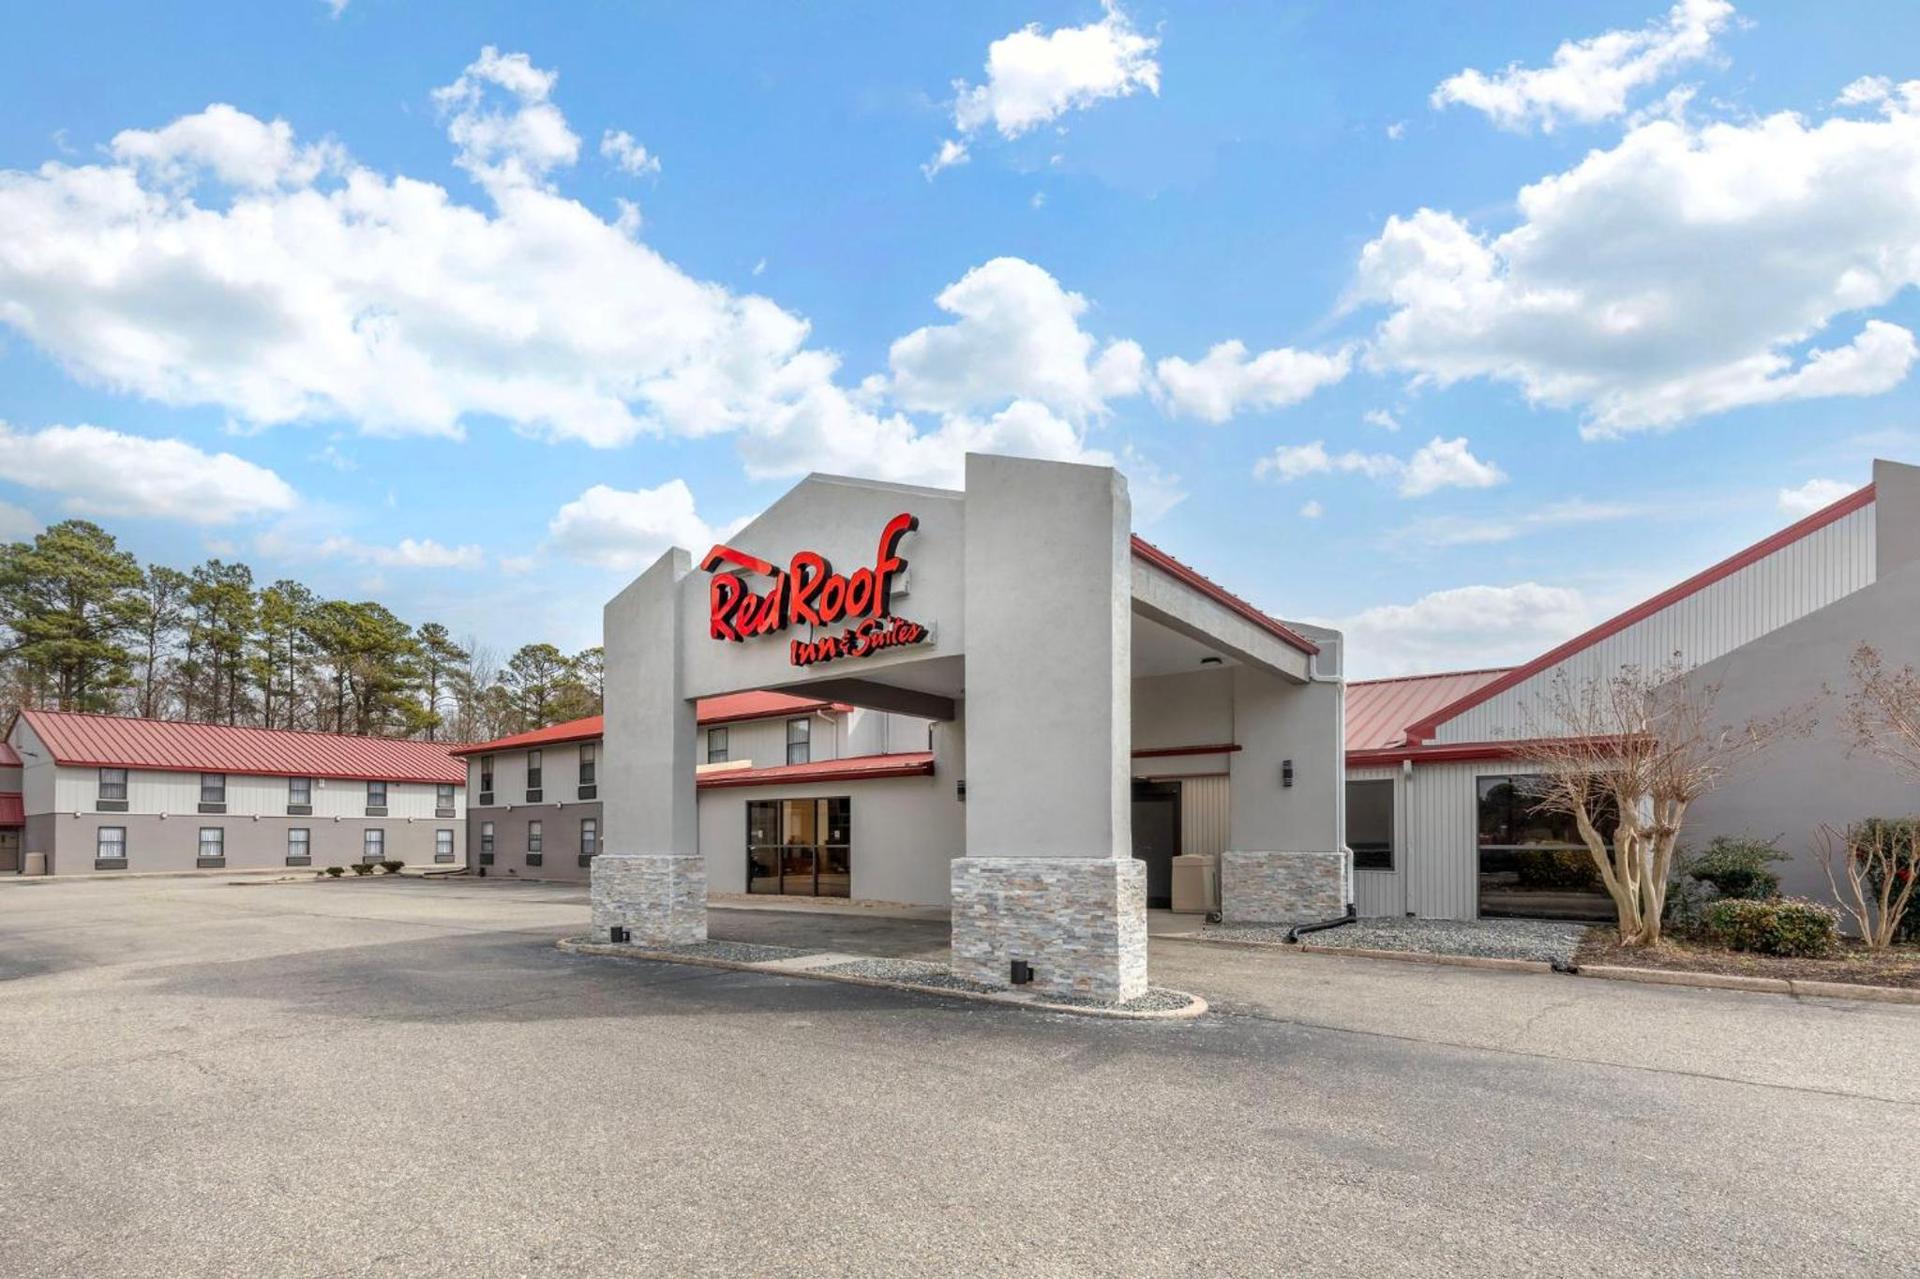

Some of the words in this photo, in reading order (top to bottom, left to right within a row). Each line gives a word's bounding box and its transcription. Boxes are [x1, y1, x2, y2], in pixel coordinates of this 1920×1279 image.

[710, 572, 786, 641] Red
[790, 513, 914, 626] Roof
[790, 636, 838, 665] Inn
[839, 629, 851, 654] &
[852, 615, 925, 657] Suites
